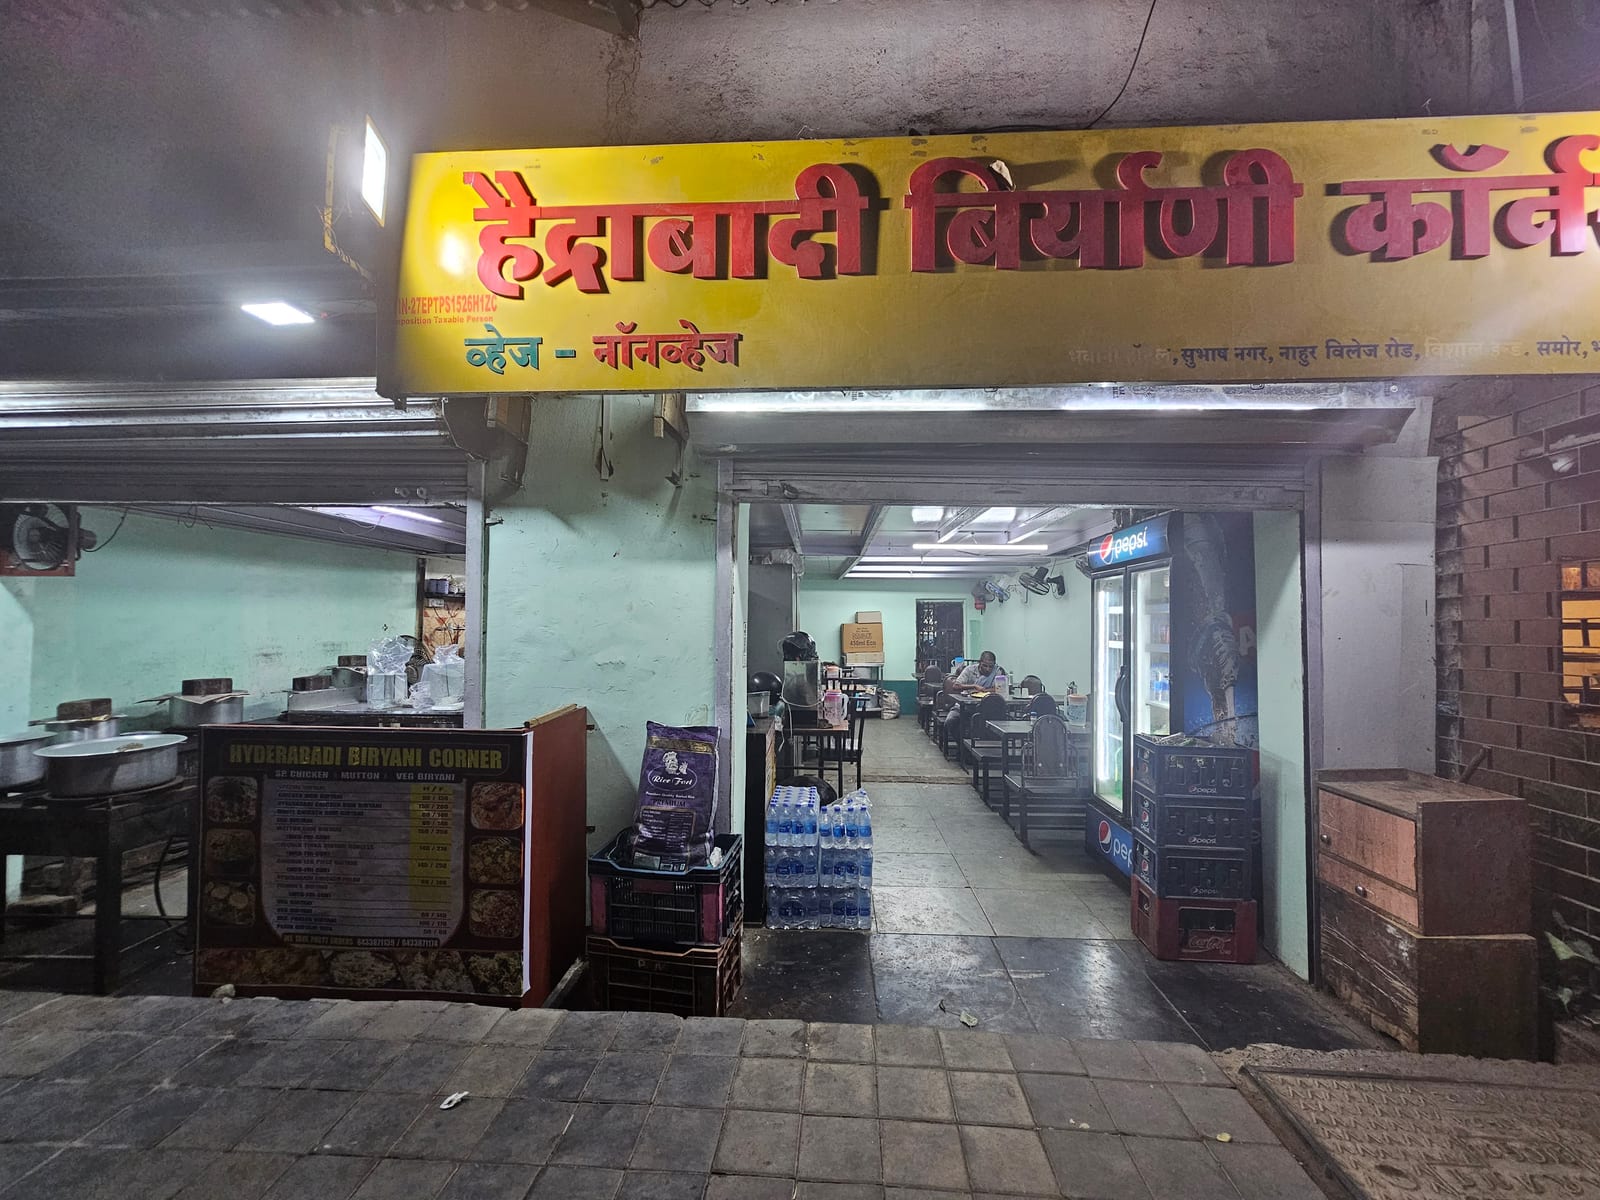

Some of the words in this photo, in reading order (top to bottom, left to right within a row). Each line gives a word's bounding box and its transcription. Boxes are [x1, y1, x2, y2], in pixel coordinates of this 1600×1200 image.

[463, 163, 868, 299] हैद्राबादी
[905, 148, 1303, 273] बिर्याणी
[433, 316, 464, 324] Taxable
[466, 315, 493, 323] Person
[464, 323, 542, 374] व्हेज
[593, 319, 743, 373] नॉनव्हेज
[1181, 347, 1228, 368] सुभाष
[1234, 347, 1273, 364] नगर,
[1279, 345, 1318, 366] नाहुर
[1325, 338, 1379, 360] विलेज
[1385, 337, 1420, 361] रोड,
[1536, 335, 1588, 359] समोर,
[1115, 526, 1148, 559] pepsi
[230, 744, 342, 767] HYDERABADI
[348, 746, 422, 768] BIRYANI
[429, 748, 503, 769] CORNER
[341, 771, 380, 781] MUTTON
[396, 772, 414, 781] VEG
[417, 773, 455, 782] BIRYANI
[651, 775, 671, 784] Rice
